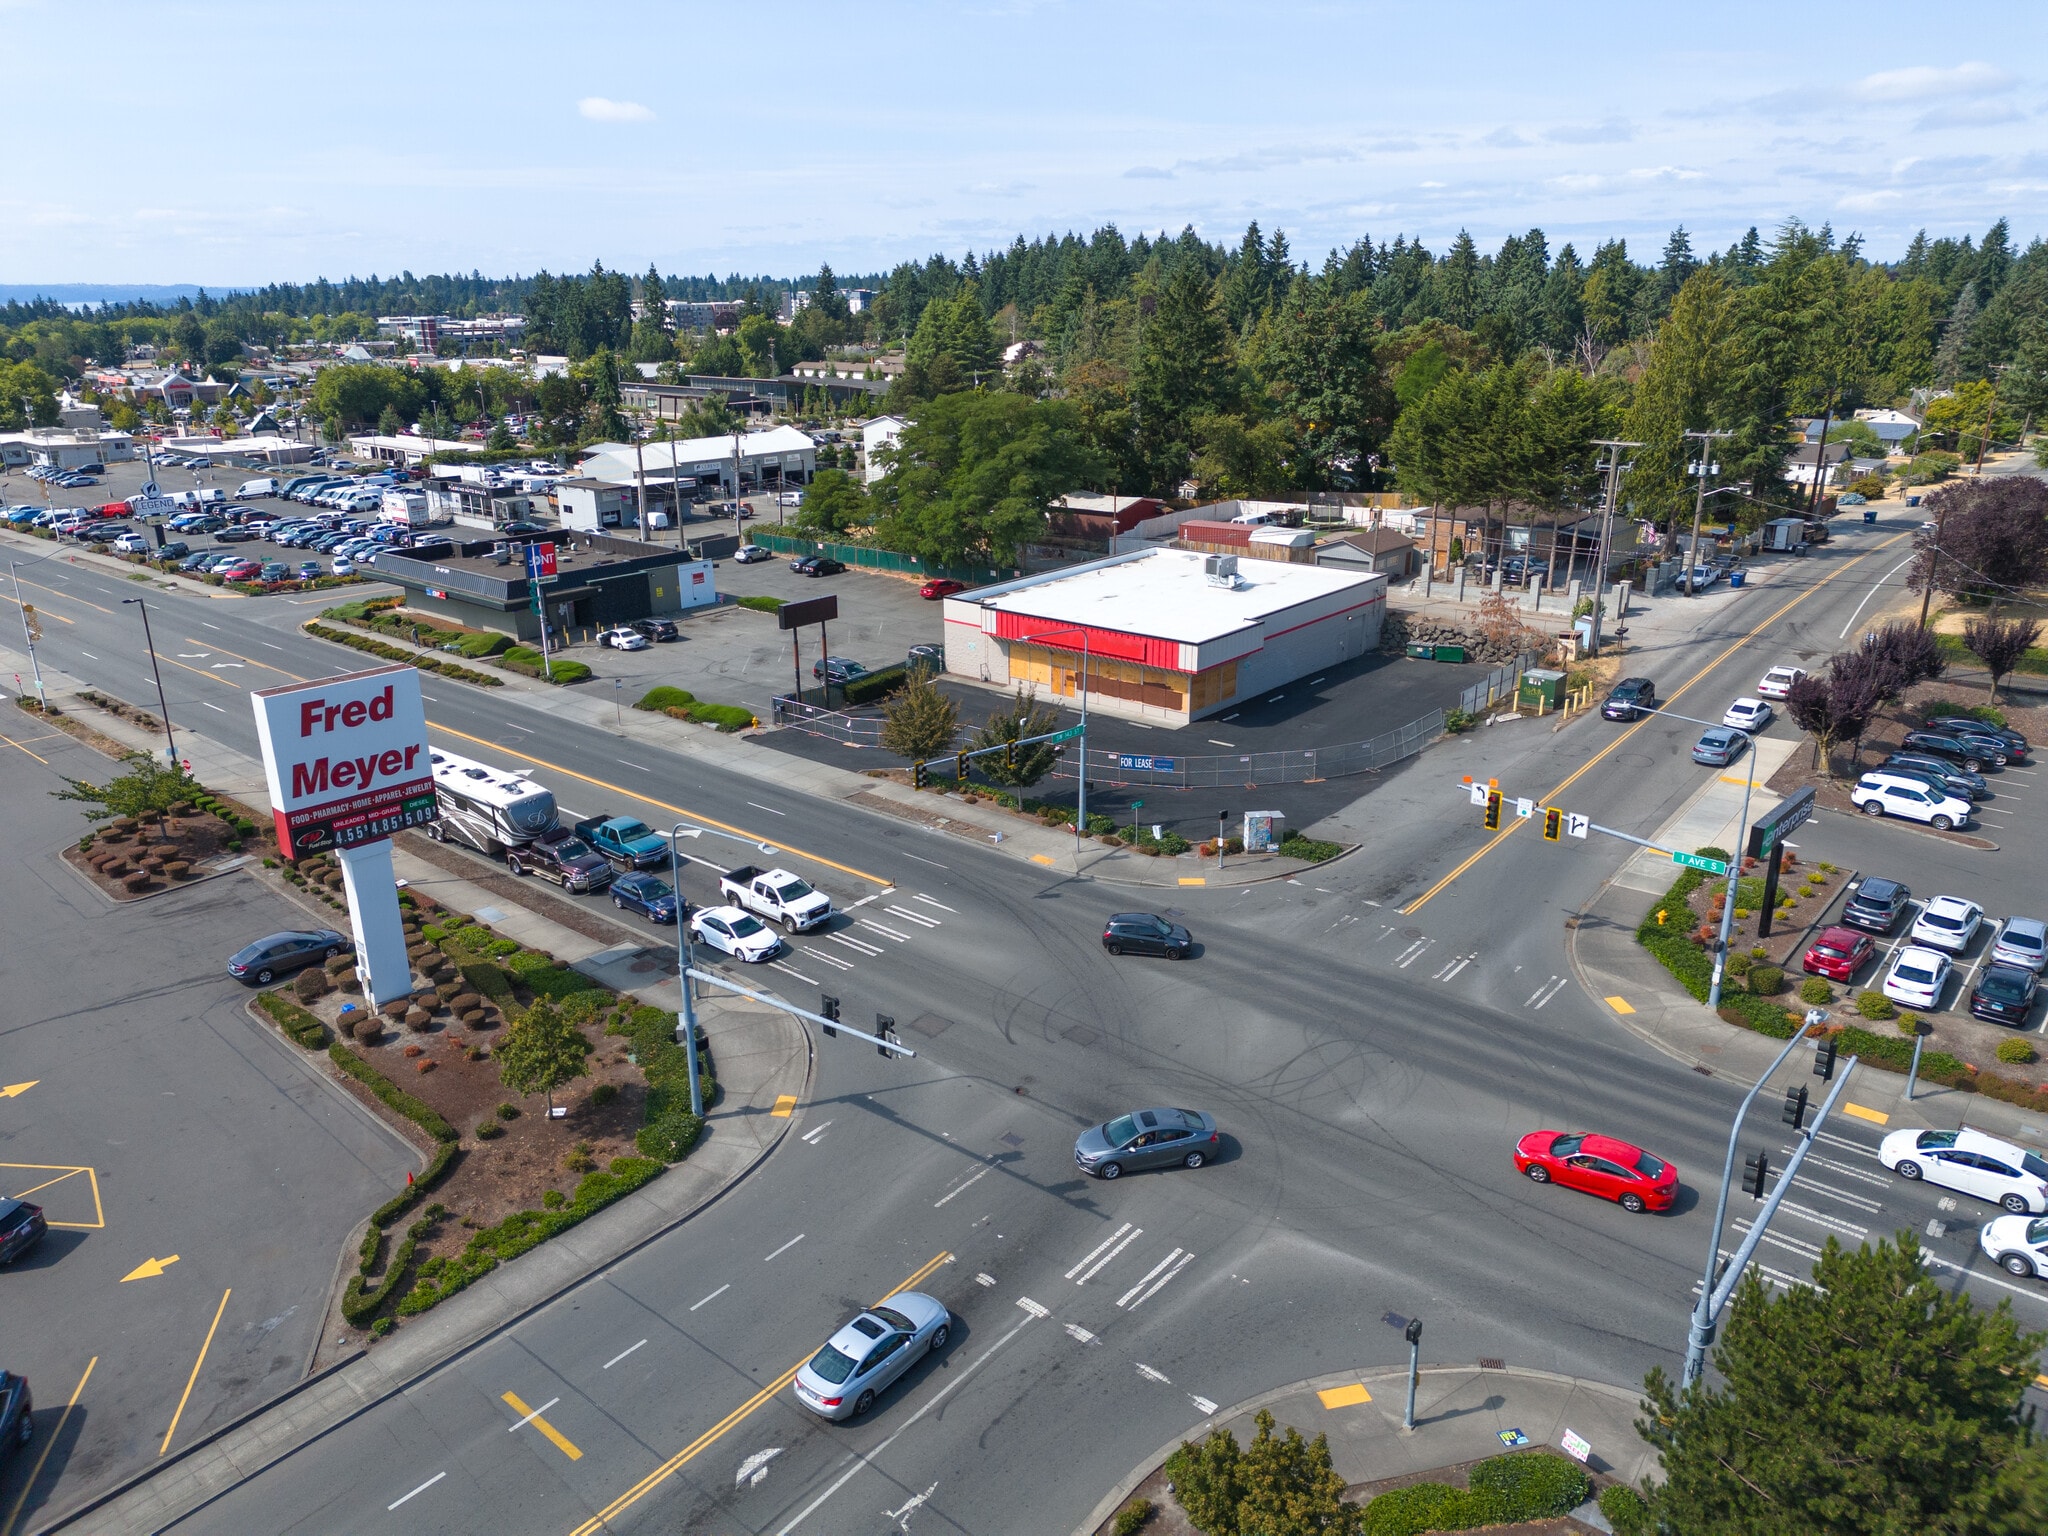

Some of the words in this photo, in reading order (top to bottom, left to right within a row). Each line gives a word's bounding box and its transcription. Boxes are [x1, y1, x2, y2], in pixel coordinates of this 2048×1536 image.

[135, 499, 174, 511] LEGEND
[301, 685, 394, 738] Fred
[292, 743, 420, 799] Meyer
[1120, 757, 1133, 768] FOR
[1135, 758, 1152, 769] LEASE
[291, 813, 310, 825] FOOD
[312, 803, 350, 820] PHARMACY
[352, 797, 372, 809] HOME
[375, 791, 403, 804] APPAREL
[404, 781, 433, 796] JEWELRY
[409, 799, 429, 808] DIESEL
[368, 805, 401, 820] MID-GRADE
[333, 815, 366, 829] UNLEADED
[1764, 799, 1814, 848] enterprise
[1681, 854, 1685, 862] 1
[1688, 856, 1706, 867] AVE
[1711, 862, 1717, 871] S
